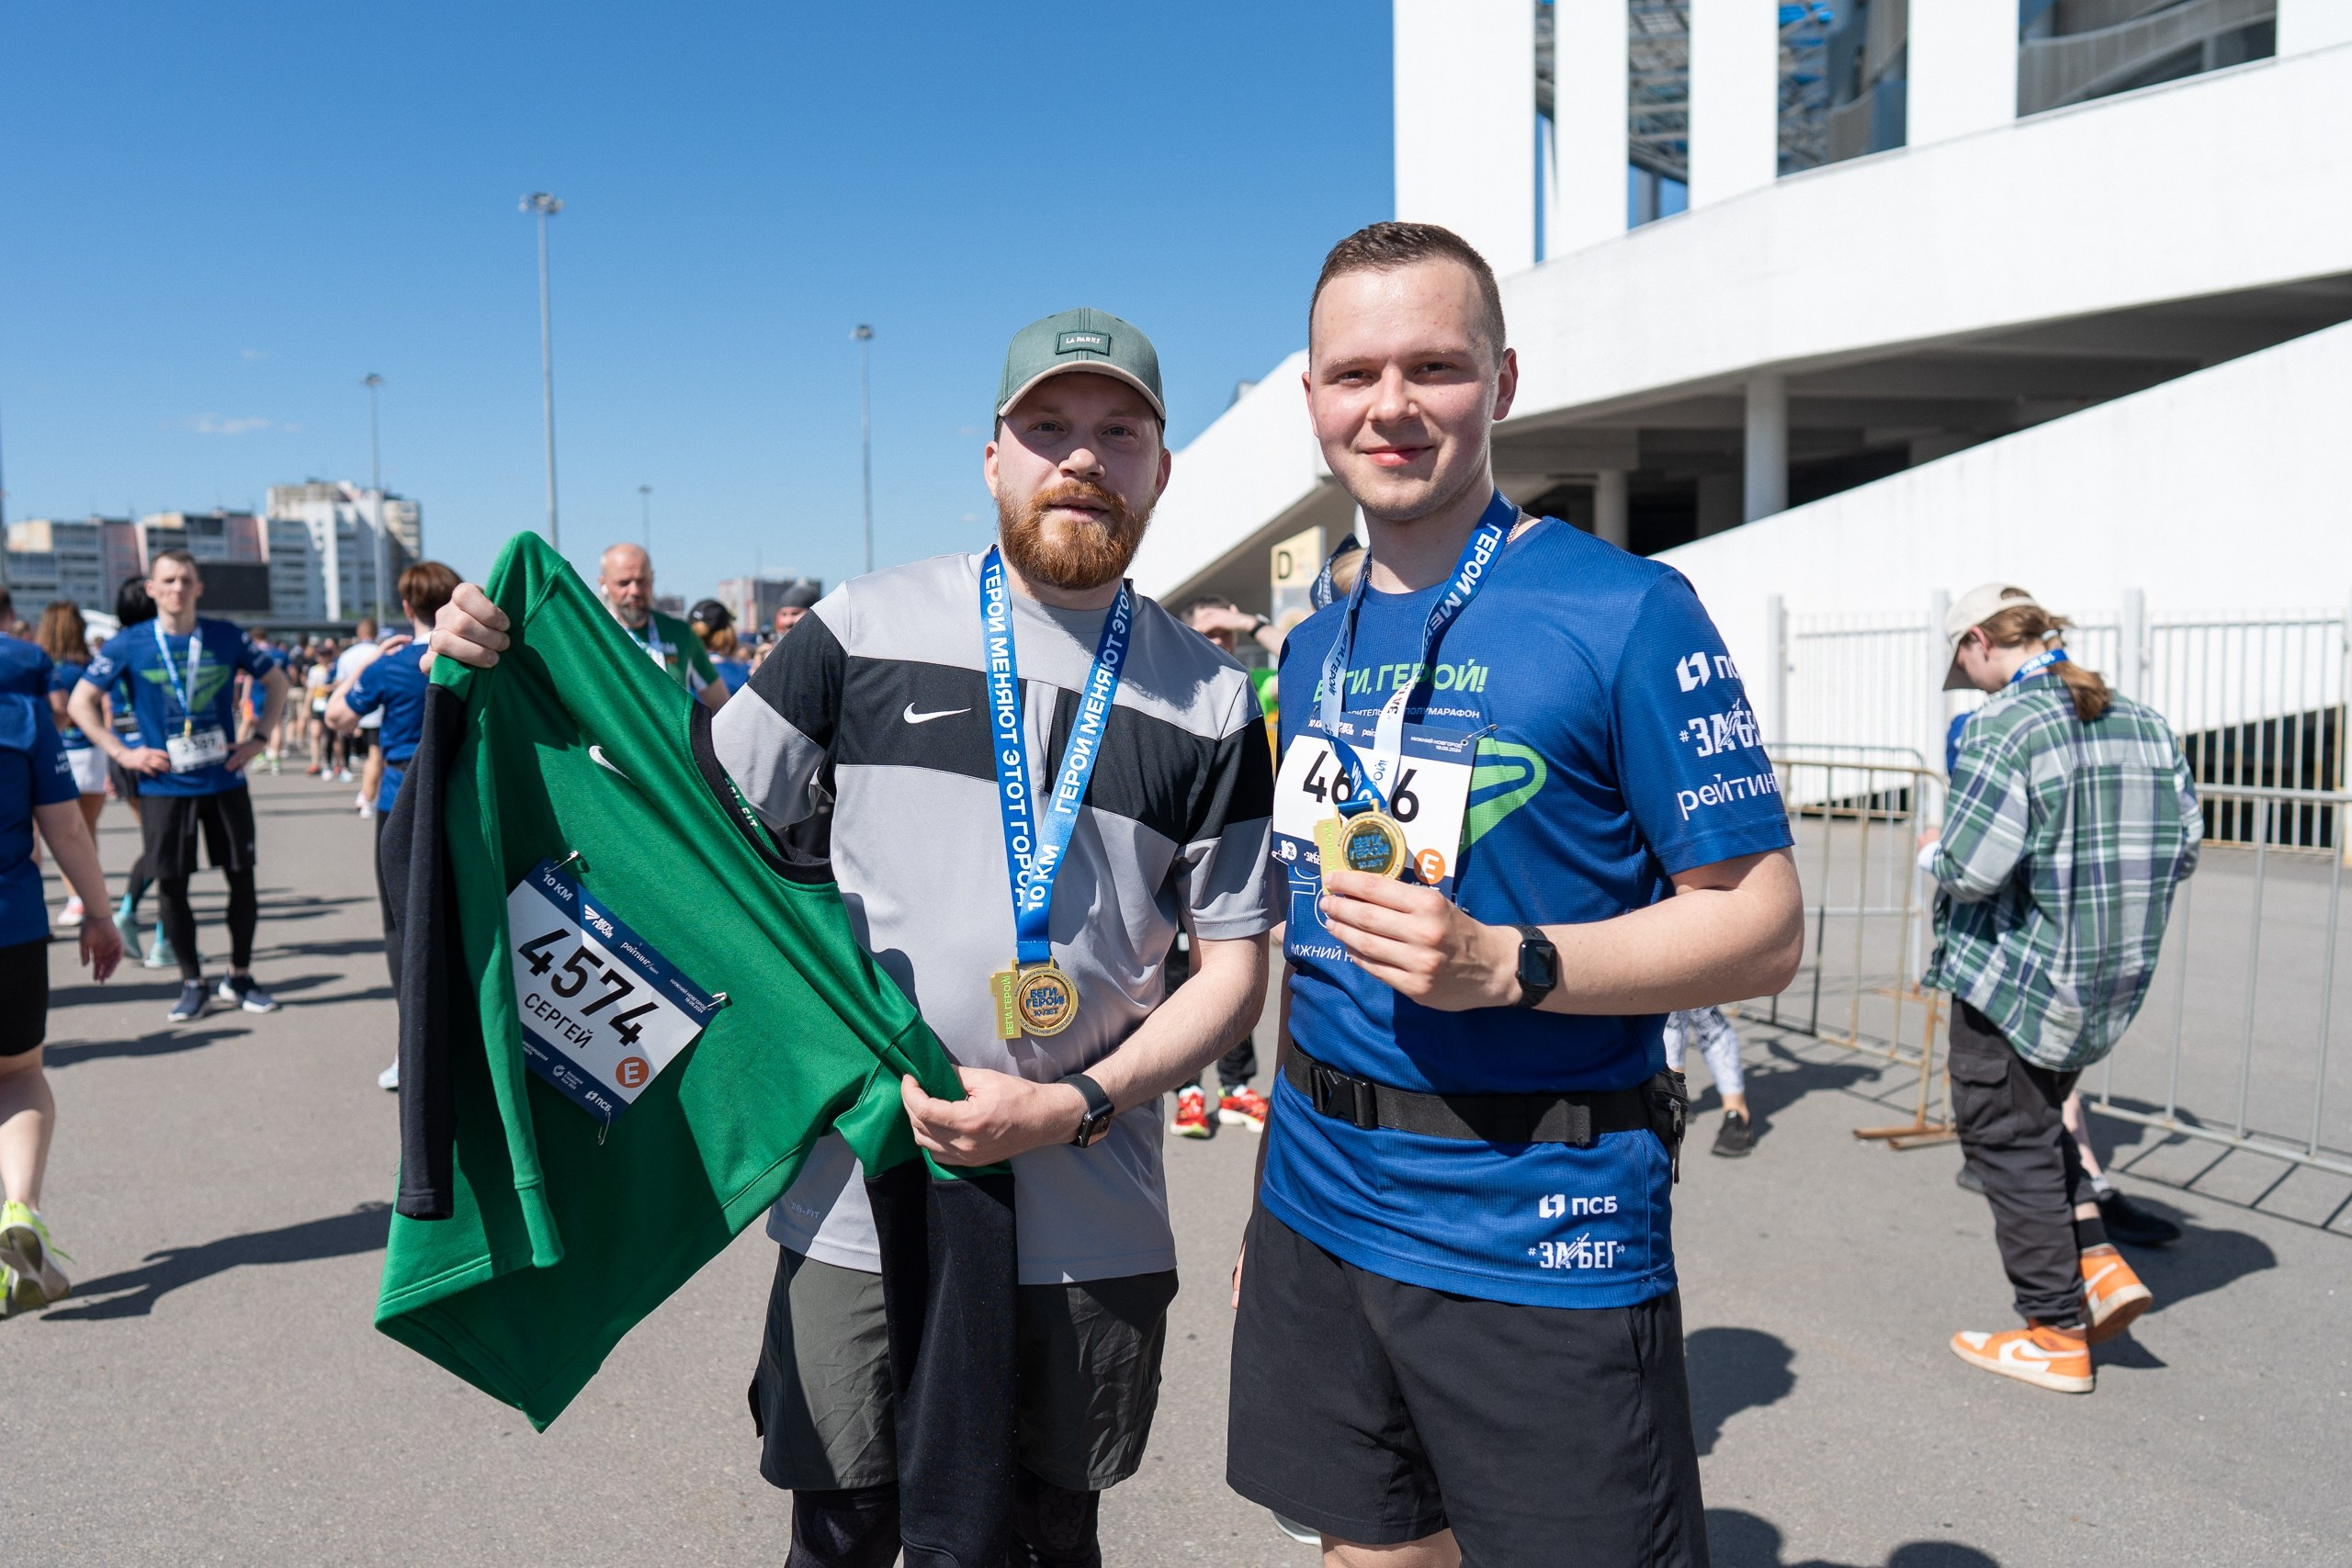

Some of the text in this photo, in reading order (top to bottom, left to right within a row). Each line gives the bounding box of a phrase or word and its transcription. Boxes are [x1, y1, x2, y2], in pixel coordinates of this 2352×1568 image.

[1076, 336, 1101, 344] PARKS
[1277, 550, 1293, 581] D
[1455, 523, 1503, 596] ГЕРОИ
[986, 563, 1007, 633] ГЕРОИ
[989, 637, 1019, 744] МЕНЯЮТ
[1313, 667, 1373, 703] БГИ,
[1376, 658, 1488, 694] ГЕРОЙ!
[1055, 739, 1093, 815] ГЕРОИ
[1080, 634, 1123, 736] МЕНЯЮТ
[1002, 749, 1026, 816] ЭТОТ
[1303, 750, 1419, 823] 466
[543, 874, 574, 901] 10 КМ
[1027, 844, 1060, 911] 10 КМ
[1419, 852, 1441, 880] E
[517, 928, 660, 1047] 4574
[524, 993, 594, 1050] СЕРГЕЙ
[624, 1061, 640, 1085] E
[594, 1097, 613, 1112] ПСБ
[791, 1202, 820, 1219] DRI-FIT
[1572, 1196, 1618, 1215] ПСБ
